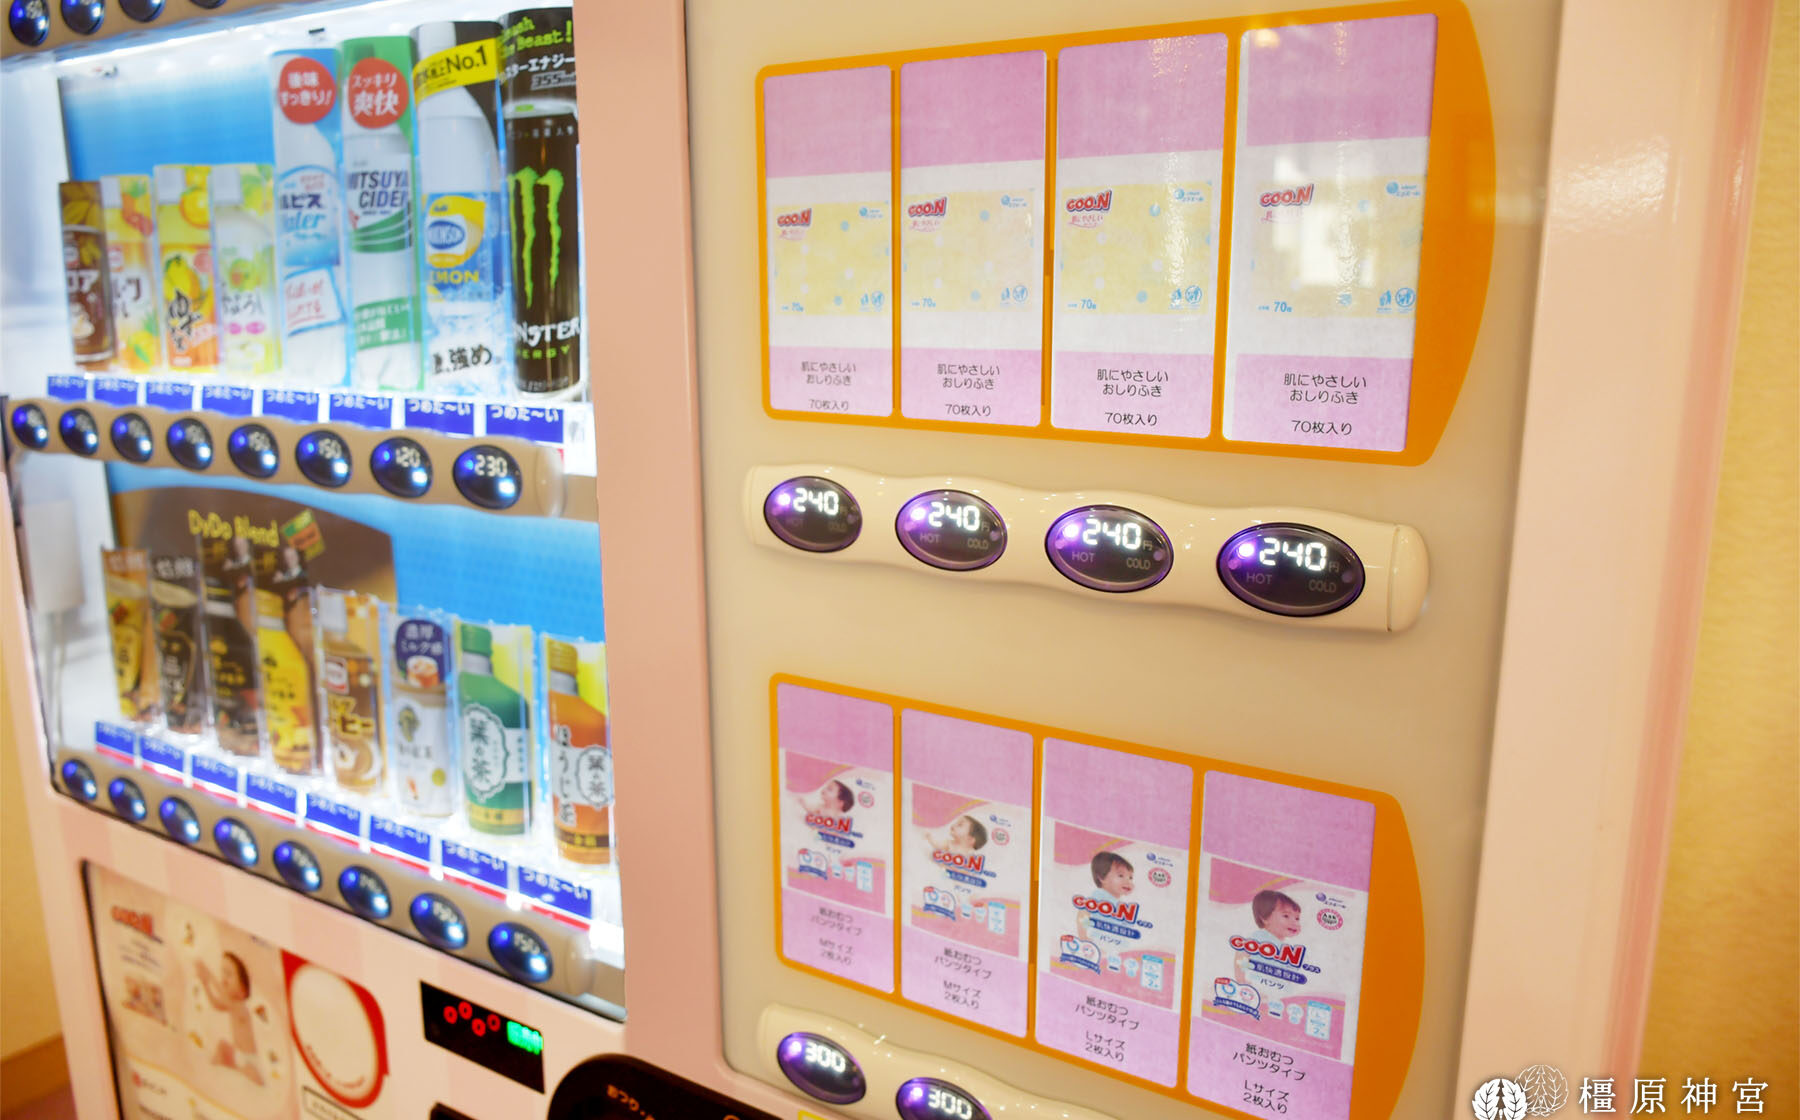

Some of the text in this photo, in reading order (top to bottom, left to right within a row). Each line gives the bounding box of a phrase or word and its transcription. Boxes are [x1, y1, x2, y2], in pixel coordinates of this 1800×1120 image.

[445, 44, 487, 73] No.1
[353, 92, 399, 116] 爽快
[802, 361, 856, 373] 肌にやさしい
[937, 364, 1000, 376] 肌にやさしい
[1097, 369, 1169, 383] 肌にやさしい
[806, 374, 851, 386] おしりふき
[943, 377, 995, 390] おしりふき
[1284, 373, 1367, 388] 肌にやさしい
[1102, 383, 1162, 397] おしりふき
[1289, 390, 1359, 405] おしりふき
[810, 399, 849, 410] 70枚入り
[945, 404, 991, 416] 70枚入り
[1104, 412, 1157, 426] 70枚入り
[1292, 420, 1352, 435] 70枚入り
[396, 446, 420, 468] 120
[474, 454, 507, 478] 230
[793, 488, 839, 515] 240
[928, 502, 980, 531] 240
[920, 533, 940, 543] HOT
[968, 538, 988, 550] COLD
[1083, 519, 1141, 550] 240
[1072, 551, 1095, 563] HOT
[1259, 537, 1326, 571] 240
[1126, 558, 1151, 570] COLD
[1246, 572, 1272, 585] HOT
[1308, 579, 1337, 593] COLD
[943, 947, 982, 966] 紙おむつ
[935, 955, 992, 980] パンツタイプ
[943, 980, 982, 998] Mサイズ
[1260, 978, 1285, 990] パンツ
[944, 991, 979, 1010] 2枚入り
[1086, 996, 1128, 1016] 紙おむつ
[1075, 1004, 1139, 1031] パンツタイプ
[1086, 1031, 1126, 1050] Lサイズ
[805, 1042, 846, 1073] 300
[1085, 1041, 1125, 1062] 2枚入り
[1246, 1042, 1294, 1066] 紙おむつ
[1233, 1052, 1306, 1081] パンツタイプ
[1244, 1080, 1290, 1102] Lサイズ
[927, 1088, 972, 1120] 300
[1243, 1092, 1288, 1114] 2枚入り
